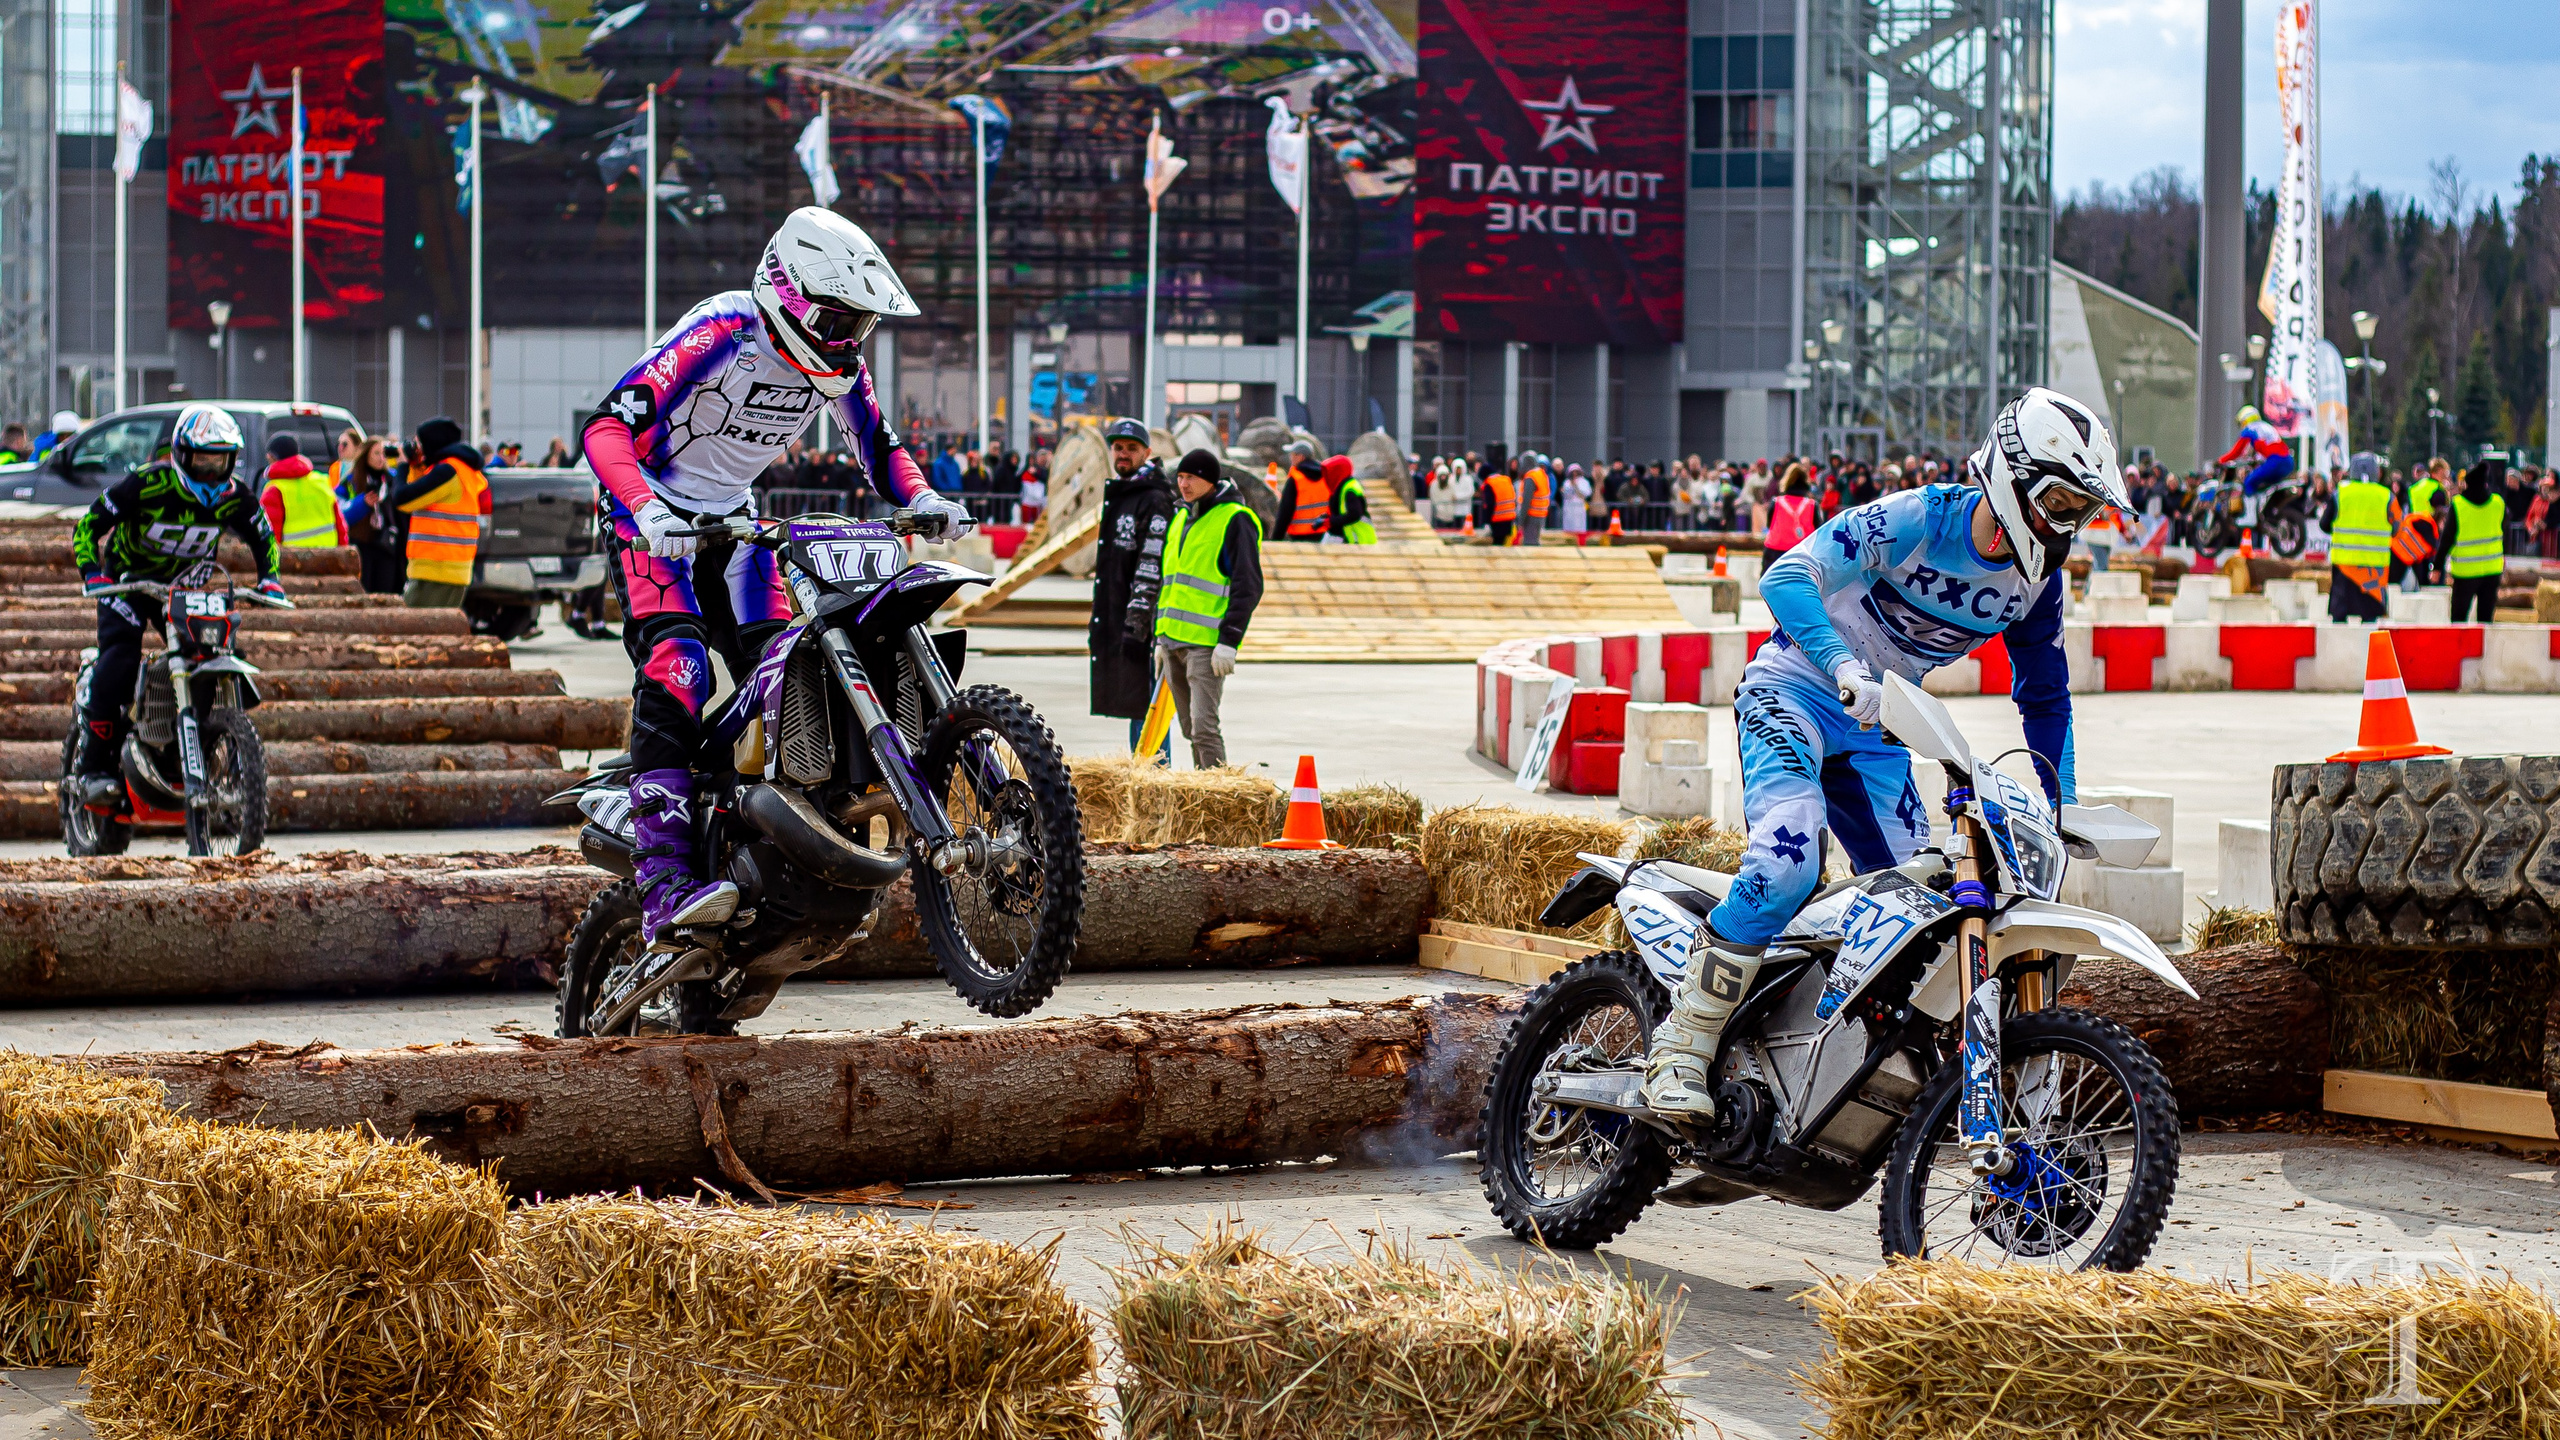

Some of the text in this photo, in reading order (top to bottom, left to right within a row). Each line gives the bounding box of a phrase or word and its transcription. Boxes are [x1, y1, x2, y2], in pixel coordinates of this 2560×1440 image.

[182, 150, 353, 187] ПАТРИОТ
[1450, 162, 1665, 201] ПАТРИОТ
[200, 189, 322, 223] ЭКСПО
[1485, 202, 1637, 236] ЭКСПО
[741, 409, 776, 422] FACTORY
[748, 386, 801, 410] KTM
[140, 521, 221, 559] 58
[806, 540, 902, 584] 177
[185, 592, 228, 617] 58
[1524, 718, 1559, 780] 15
[870, 747, 903, 803] FACTORY RACING
